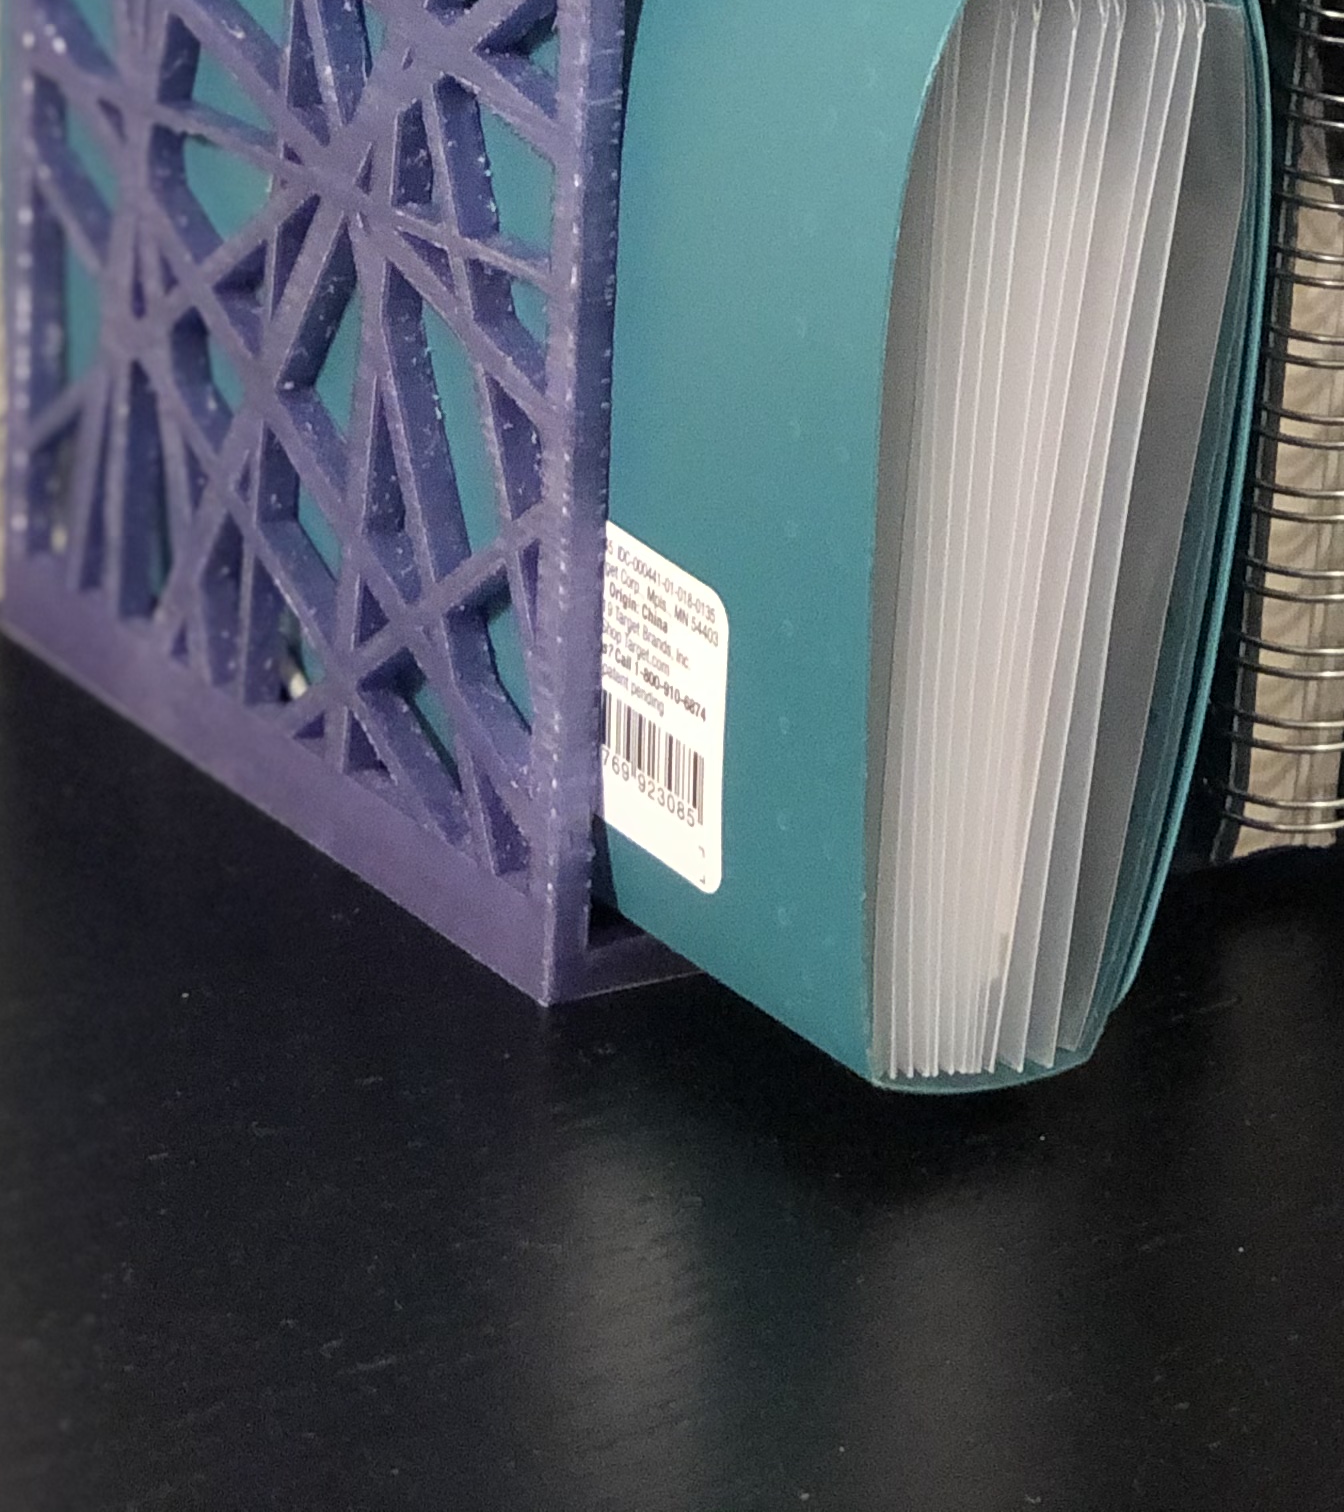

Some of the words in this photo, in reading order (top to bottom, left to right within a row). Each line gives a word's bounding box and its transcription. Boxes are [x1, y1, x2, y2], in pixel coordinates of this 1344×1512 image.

[642, 603, 668, 634] China
[674, 604, 689, 627] MN
[615, 647, 632, 671] Call
[638, 773, 695, 828] 923085
